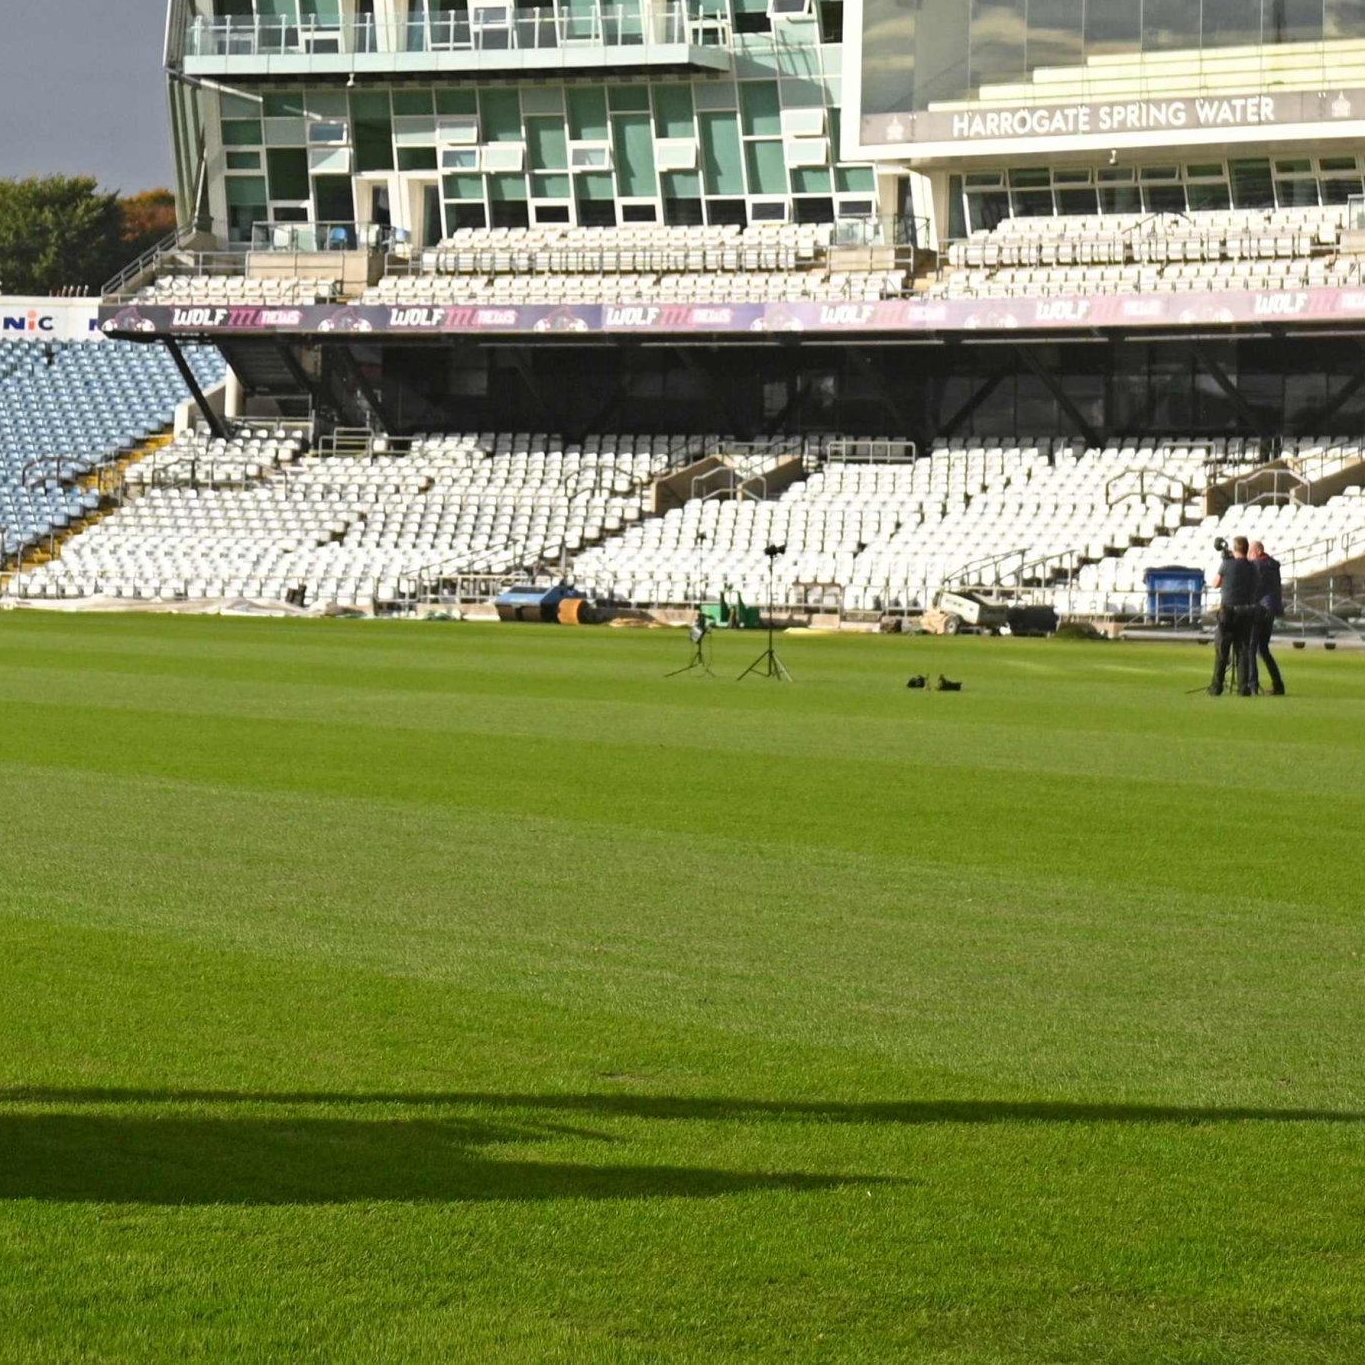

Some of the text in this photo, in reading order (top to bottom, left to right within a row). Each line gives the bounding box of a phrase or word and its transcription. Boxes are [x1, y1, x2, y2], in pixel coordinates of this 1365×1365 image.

[953, 96, 1274, 138] HARROGATE SPRING WATER
